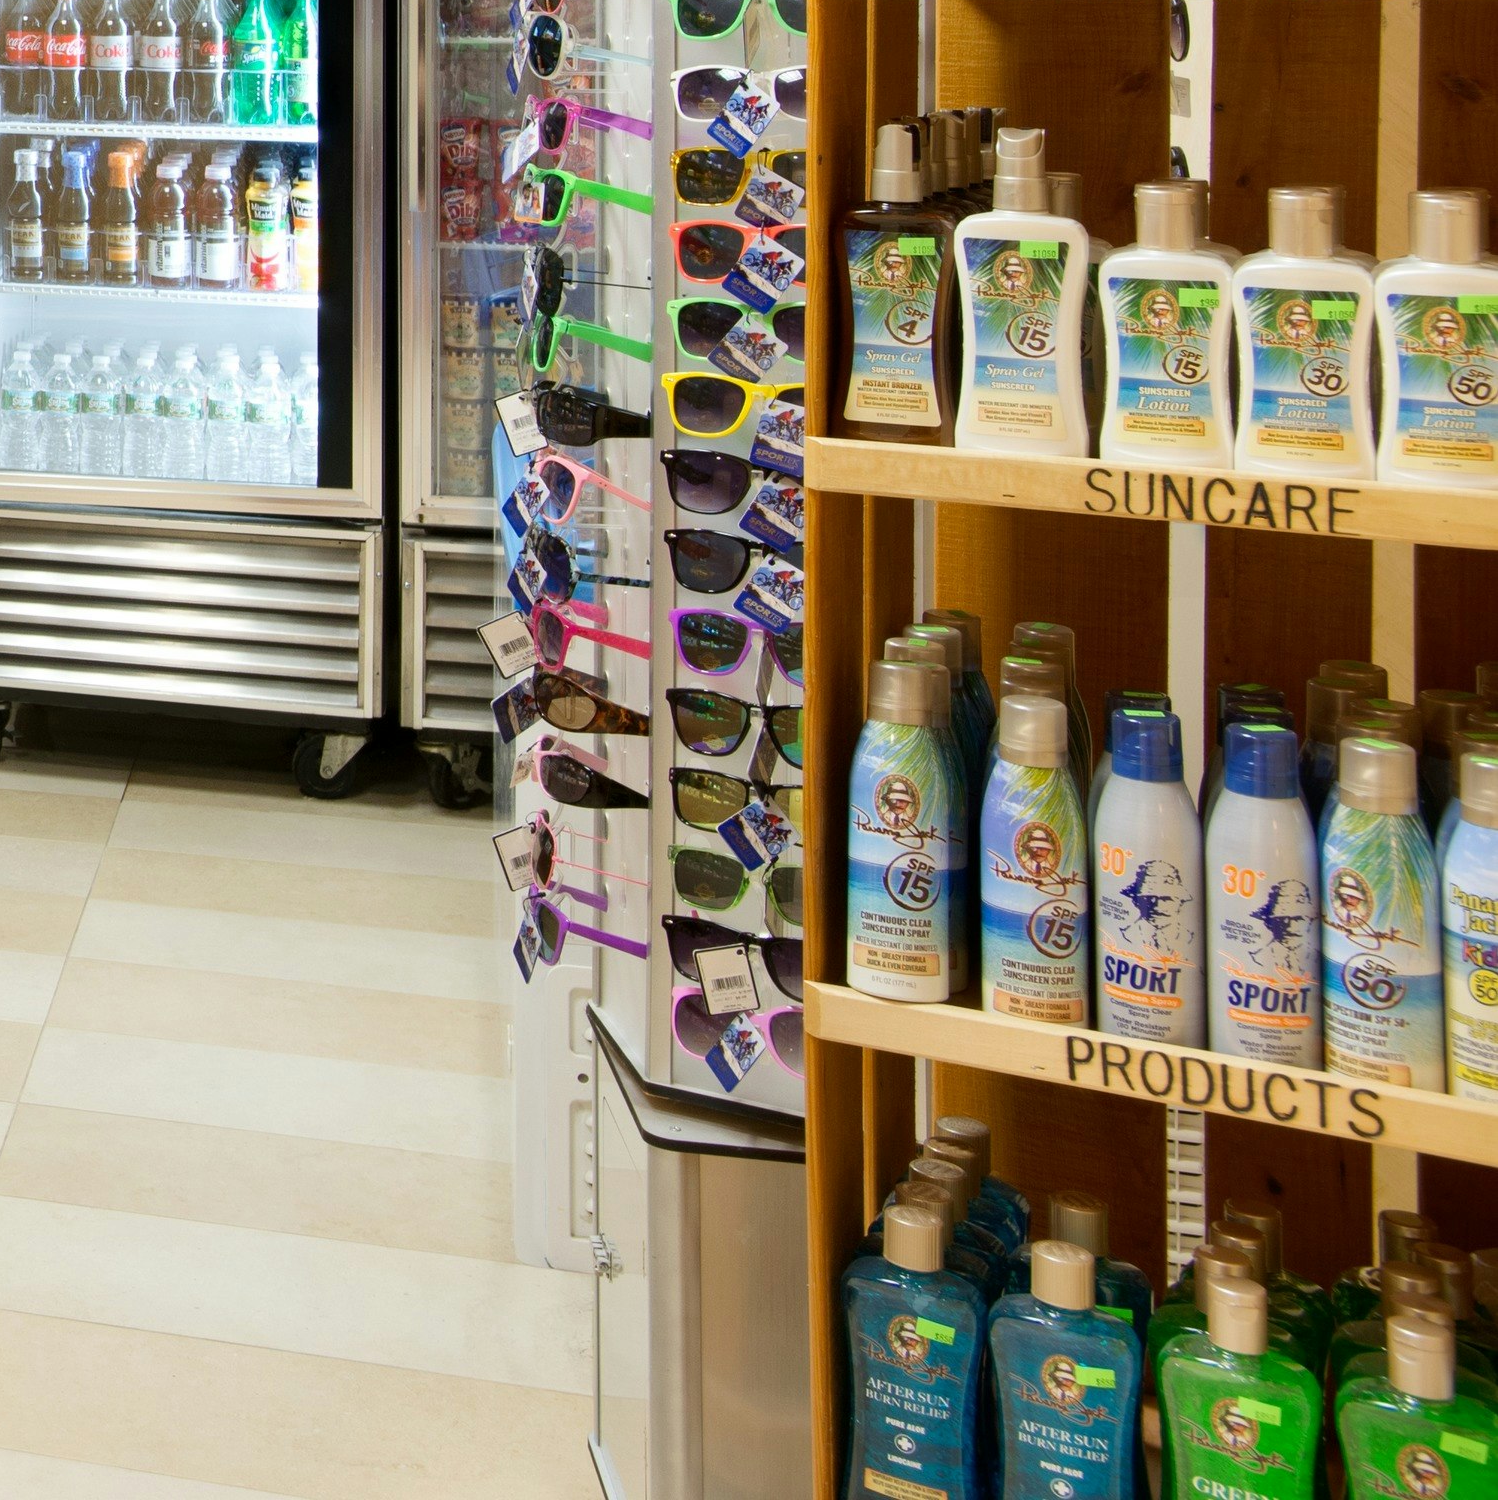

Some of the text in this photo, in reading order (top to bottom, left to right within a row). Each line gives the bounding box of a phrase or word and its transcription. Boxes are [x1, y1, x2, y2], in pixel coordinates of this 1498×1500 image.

[95, 42, 129, 59] Coke
[146, 42, 182, 59] Coke
[902, 305, 930, 321] SPF
[1024, 315, 1054, 331] SPF
[1017, 326, 1050, 352] 15
[864, 349, 923, 365] Spray Gel
[1179, 348, 1203, 362] SPF
[984, 363, 1045, 380] Spray Gel
[1173, 356, 1202, 379] 15
[862, 379, 891, 389] INSTANT
[1306, 368, 1343, 392] 30
[1135, 396, 1191, 413] Lotion
[1084, 467, 1362, 538] SUNCARE
[906, 857, 936, 876] SPF
[896, 870, 934, 903] 15
[860, 911, 932, 928] CONTINUOUS CLEAR
[1050, 905, 1079, 923] SPF
[861, 921, 931, 939] SUNSCREEN SPRAY
[1041, 918, 1076, 951] 15
[1001, 958, 1076, 975] CONTINUOUS CLEAR
[1104, 954, 1182, 995] SPORT
[1362, 958, 1397, 978] SPF
[1003, 968, 1075, 986] SUNSCREEN SPRAY
[1227, 979, 1312, 1015] SPORT
[1065, 1034, 1387, 1141] PRODUCTS
[866, 1377, 950, 1409] AFTER SUN
[865, 1388, 951, 1420] BURN RELIEF
[1018, 1418, 1109, 1451] AFTER SUN
[1017, 1431, 1110, 1464] BURN RELIEF
